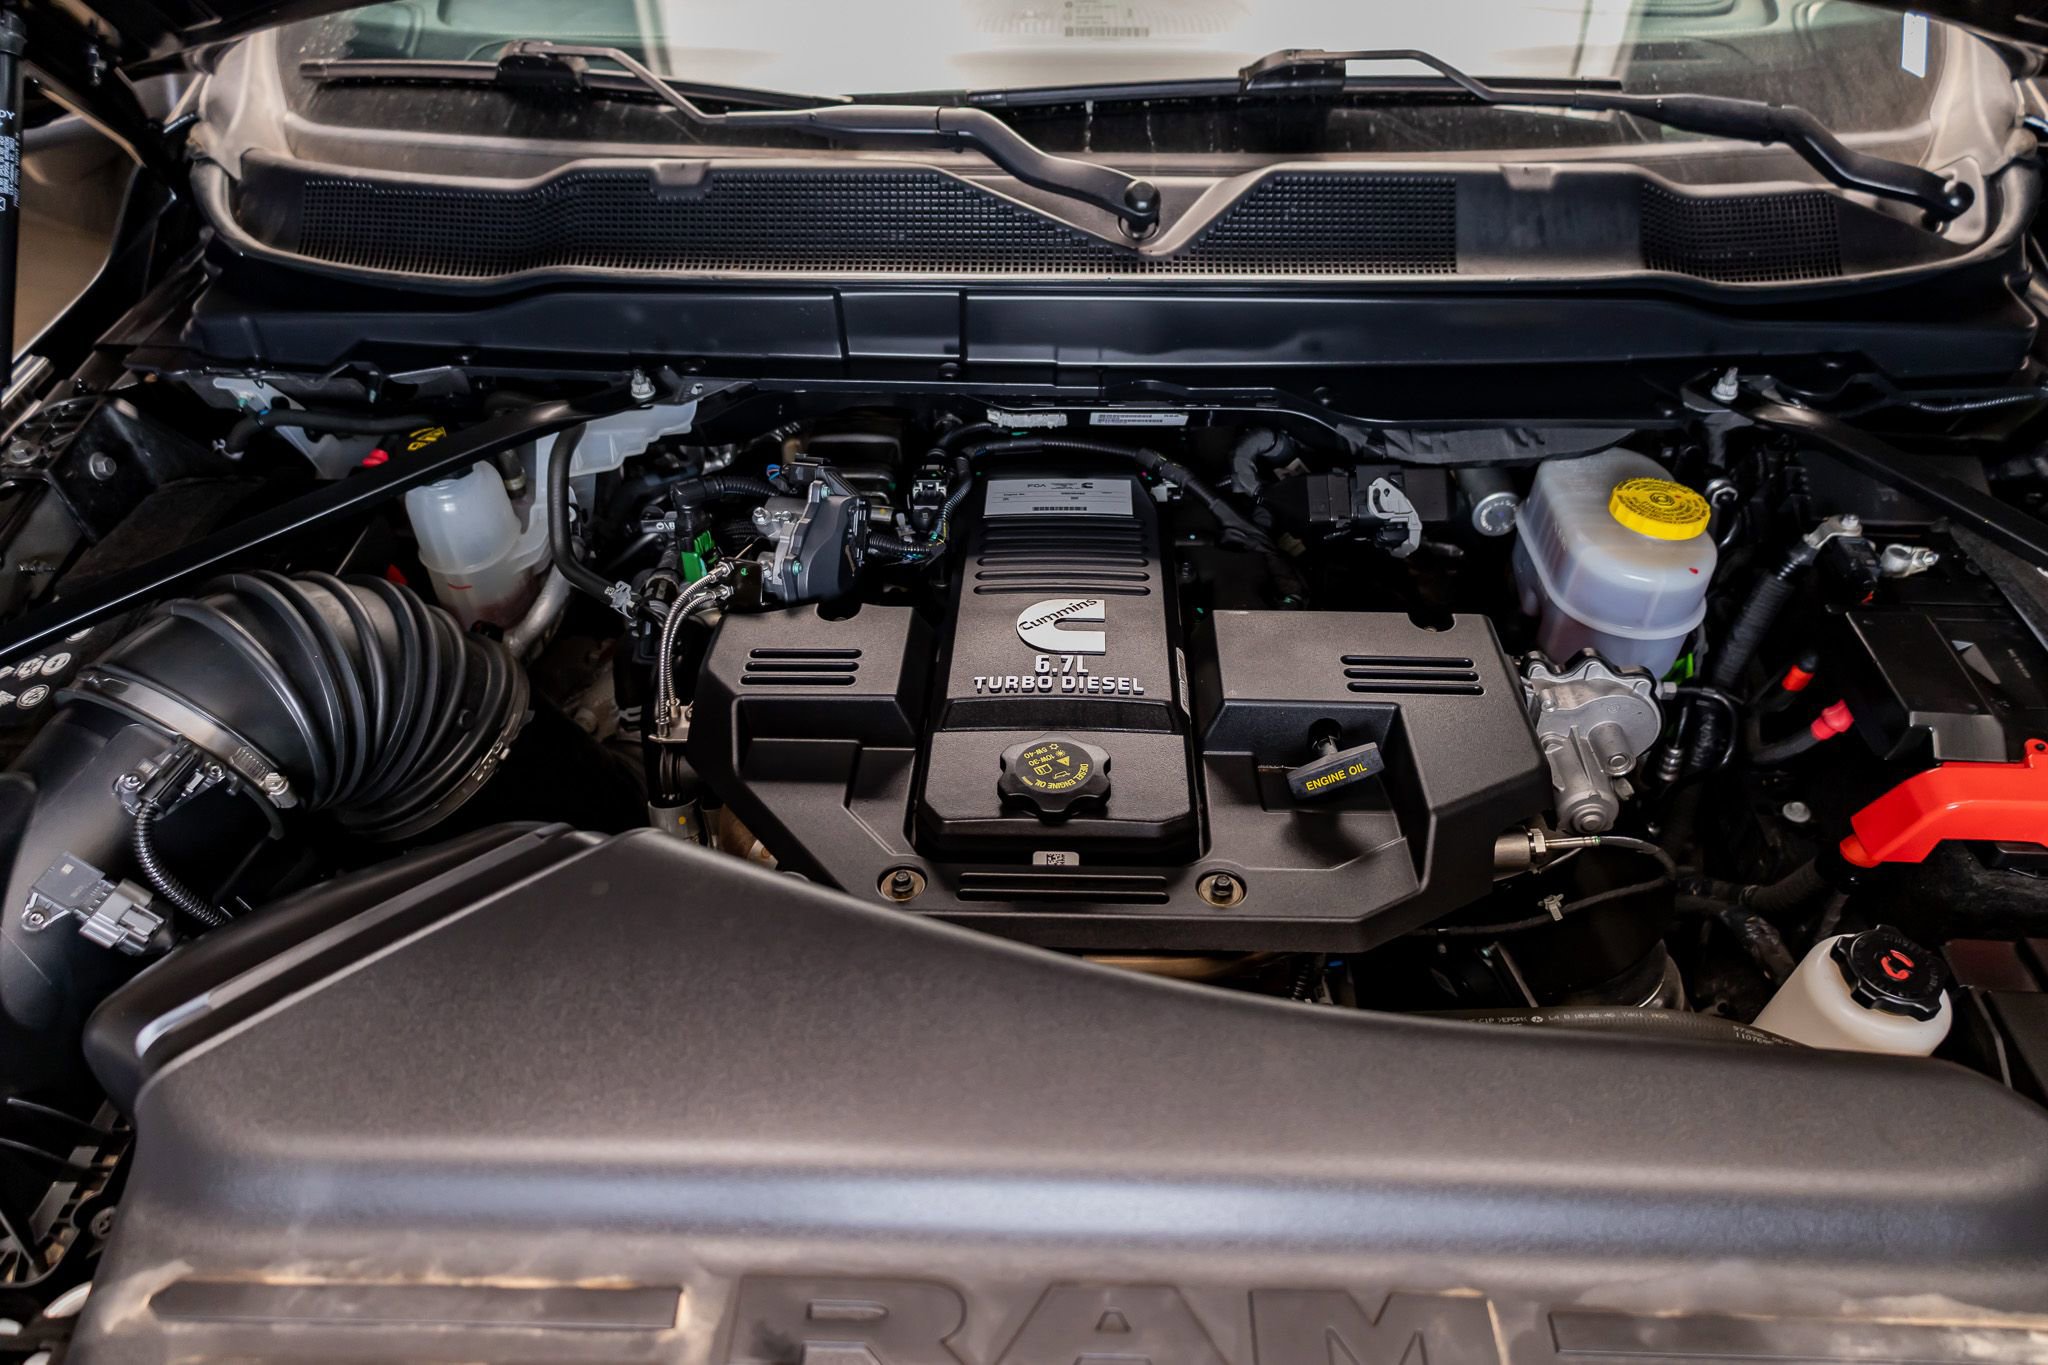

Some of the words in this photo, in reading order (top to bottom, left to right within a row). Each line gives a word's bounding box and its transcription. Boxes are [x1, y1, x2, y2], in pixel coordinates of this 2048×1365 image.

[1018, 599, 1098, 631] Cummins
[1035, 654, 1089, 677] 6.7L
[974, 675, 1053, 693] TURBO
[1061, 677, 1144, 694] DIESEL
[1023, 746, 1048, 759] 5W-40
[1028, 753, 1055, 767] 10W-30
[1072, 763, 1089, 781] DIESEL
[1305, 769, 1347, 791] ENGINE
[1348, 763, 1367, 775] OIL
[1034, 778, 1047, 788] OIL
[1047, 778, 1076, 789] ENGINE
[726, 1274, 1508, 1365] RAM
